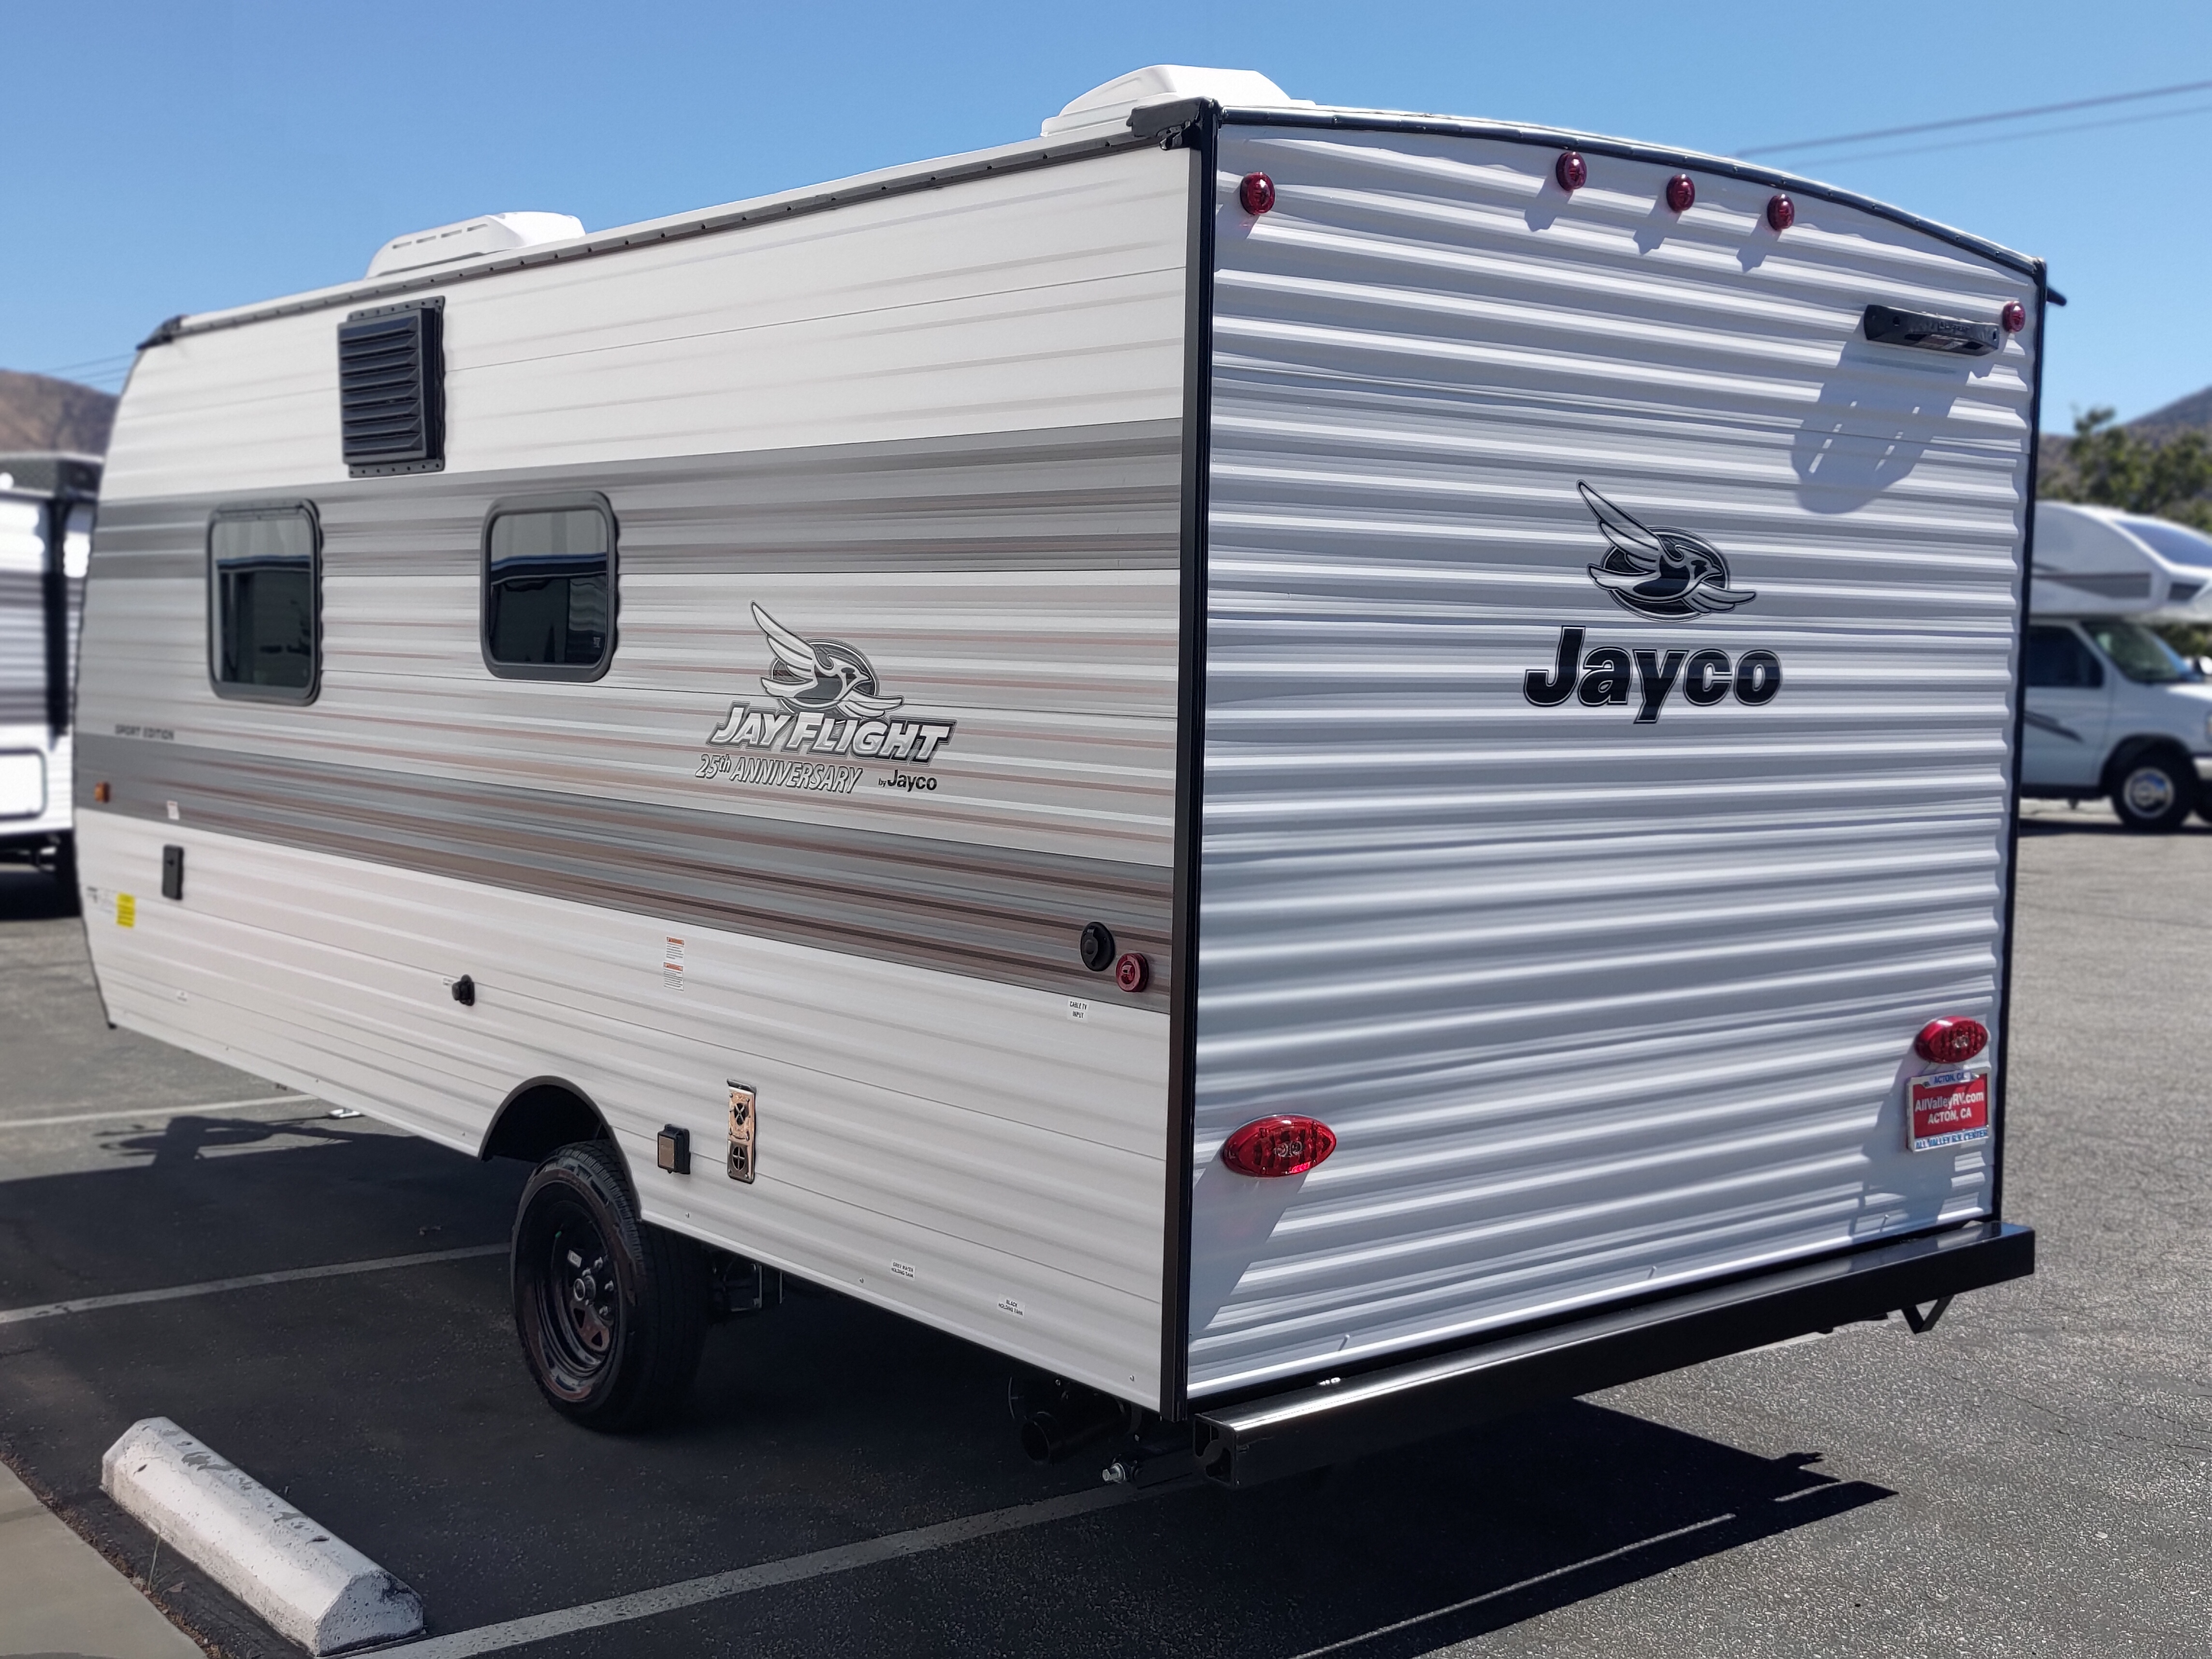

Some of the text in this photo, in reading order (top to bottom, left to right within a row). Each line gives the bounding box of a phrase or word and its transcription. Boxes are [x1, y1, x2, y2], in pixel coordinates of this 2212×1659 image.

[1523, 625, 1783, 724] Jayco
[115, 724, 175, 741] SPORT EDITION
[707, 701, 956, 766] JAY FLIGHT
[695, 753, 863, 794] 25th ANNIVERSARY
[887, 769, 938, 792] Jayco
[1915, 1091, 1984, 1112] AllValleyRV.com
[1928, 1107, 1972, 1124] ACTON, CA
